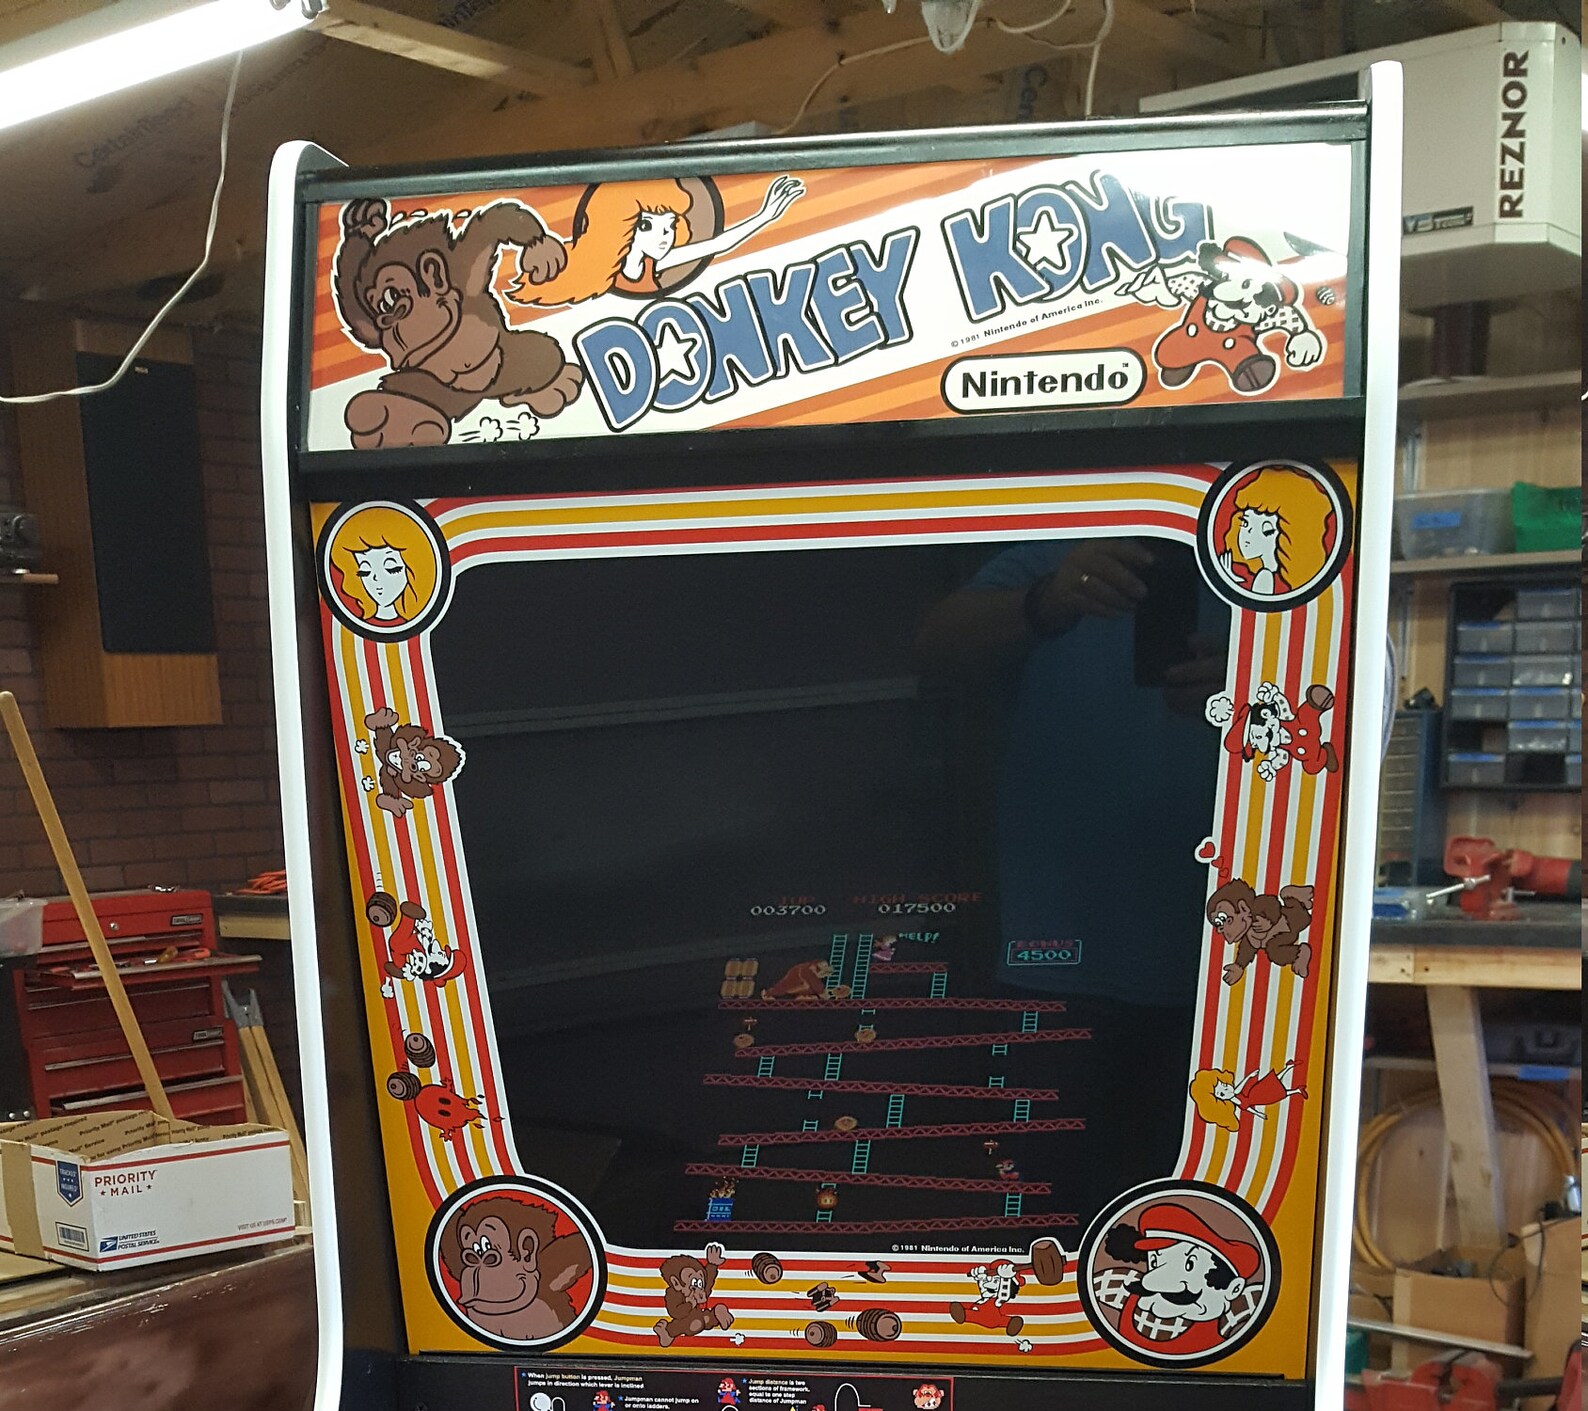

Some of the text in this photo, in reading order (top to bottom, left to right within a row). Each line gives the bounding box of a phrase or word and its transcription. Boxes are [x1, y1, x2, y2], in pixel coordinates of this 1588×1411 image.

[1499, 49, 1529, 219] REZNOR
[573, 172, 1213, 432] DONKEY KONG
[984, 320, 1027, 337] Nintendo
[1030, 315, 1039, 323] of
[1041, 303, 1083, 320] America
[962, 363, 1129, 398] Nintendo
[750, 903, 956, 916] 003700 017500
[1017, 950, 1071, 960] 4500
[95, 1170, 157, 1187] PRIORITY
[110, 1185, 143, 1196] MAIL
[118, 1230, 156, 1241] UNITED STATES
[118, 1241, 137, 1250] POSTAL
[625, 1395, 653, 1403] Jumpman
